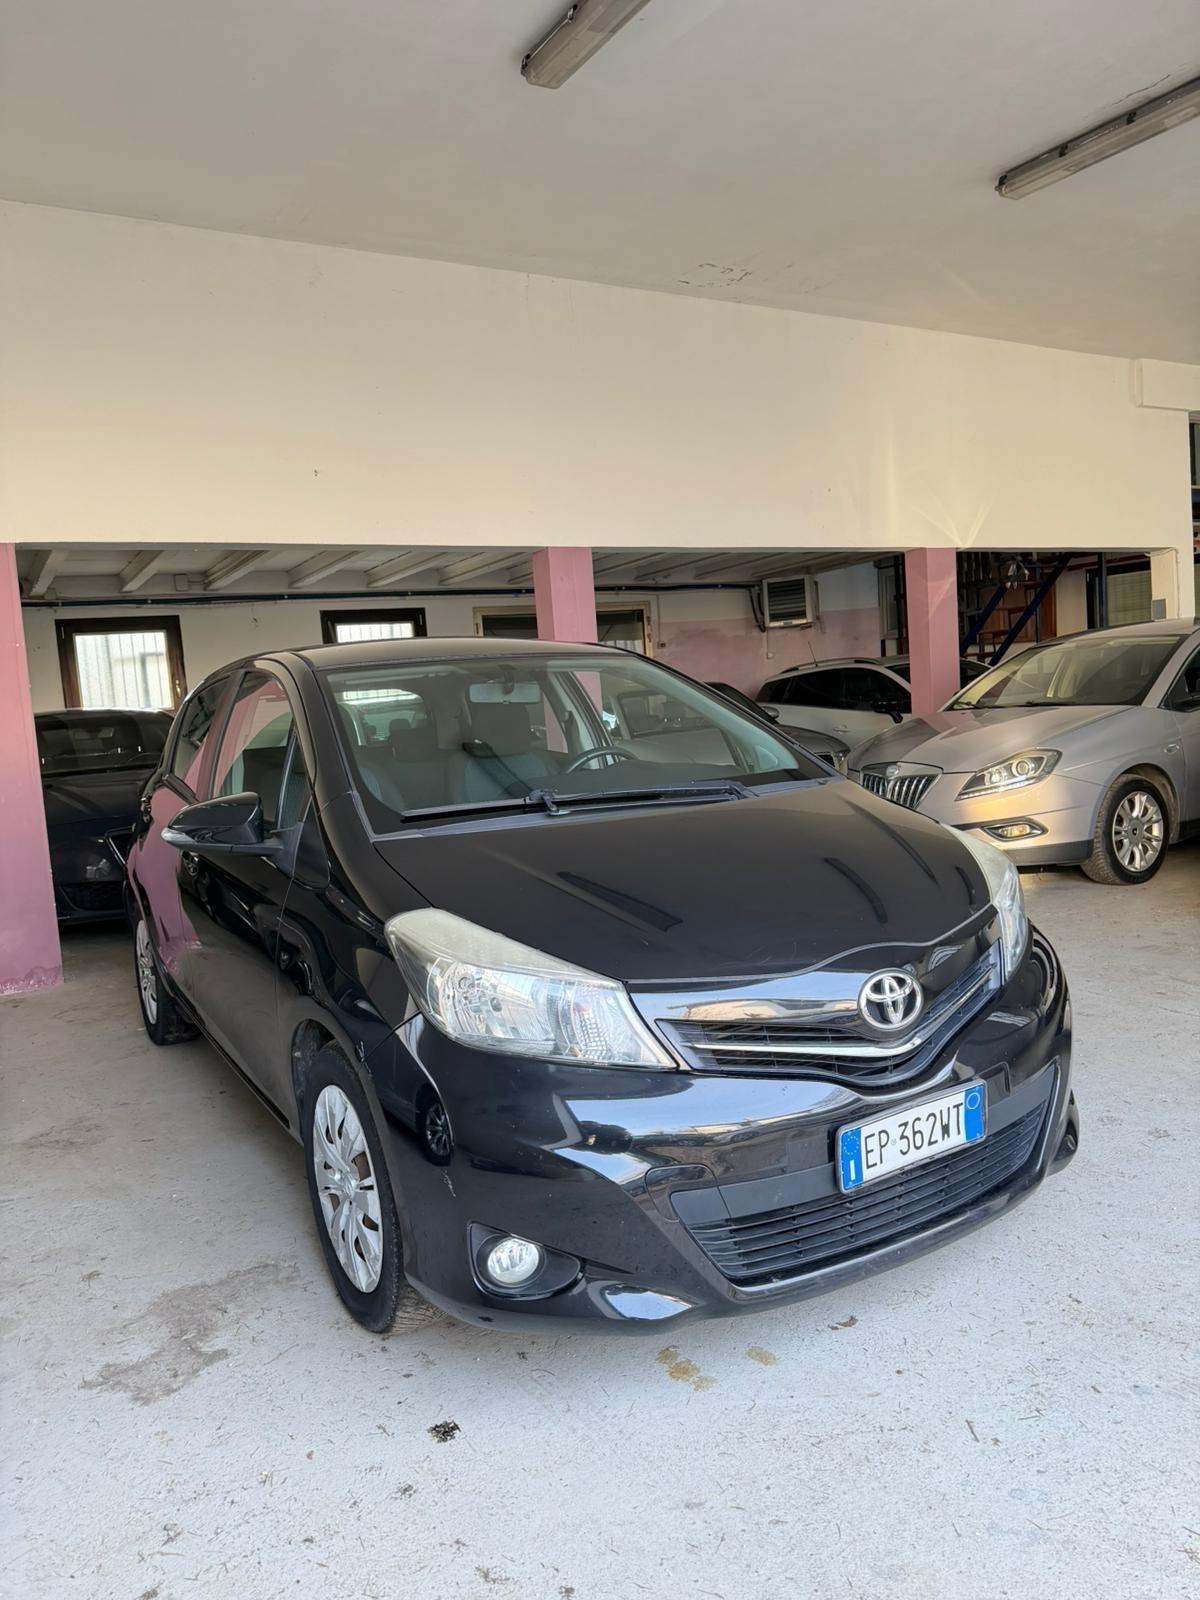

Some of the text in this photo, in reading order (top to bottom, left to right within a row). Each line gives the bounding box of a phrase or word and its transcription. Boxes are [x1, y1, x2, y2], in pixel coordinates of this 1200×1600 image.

[864, 1102, 964, 1169] EP 362WT
[849, 1159, 856, 1181] I
